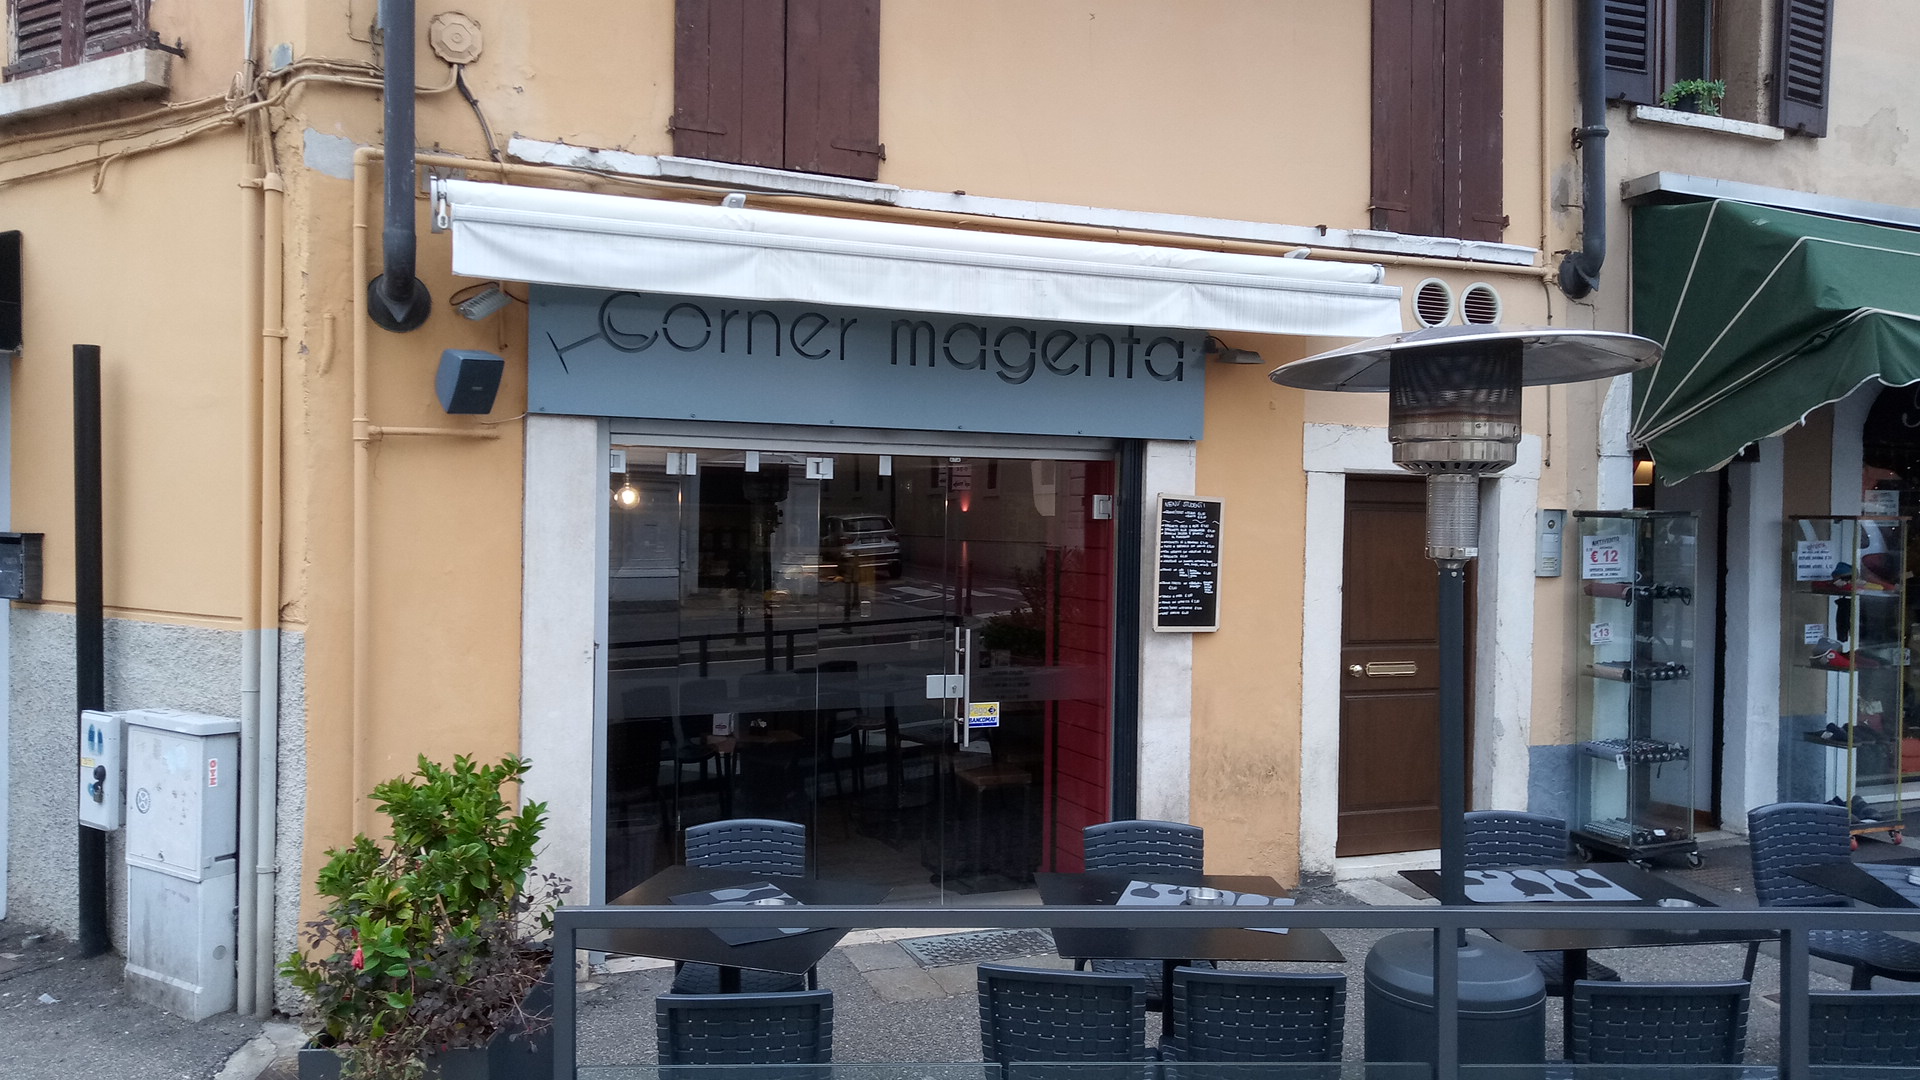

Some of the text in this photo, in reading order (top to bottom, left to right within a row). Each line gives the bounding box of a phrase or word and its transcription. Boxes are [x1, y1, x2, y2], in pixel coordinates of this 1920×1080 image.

[600, 291, 1184, 385] Corner magenta
[1590, 549, 1619, 563] € 12
[1598, 628, 1610, 637] 13
